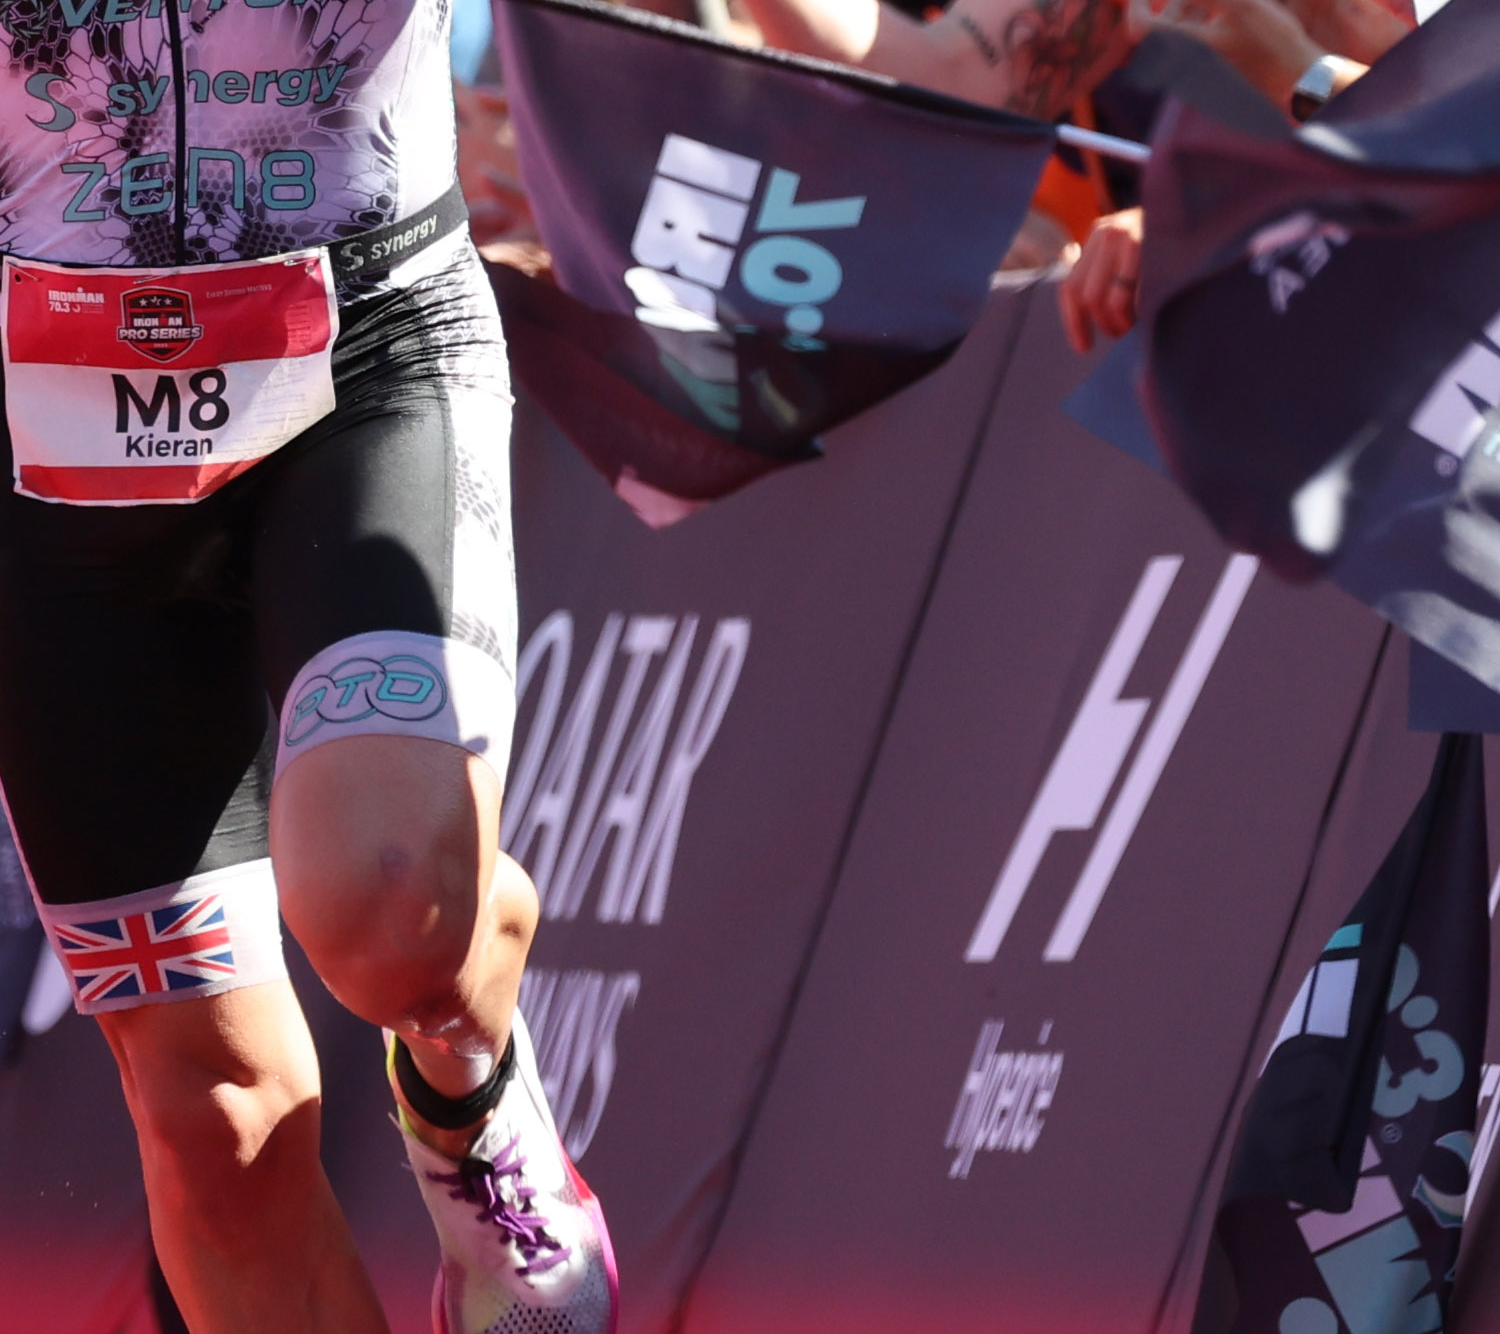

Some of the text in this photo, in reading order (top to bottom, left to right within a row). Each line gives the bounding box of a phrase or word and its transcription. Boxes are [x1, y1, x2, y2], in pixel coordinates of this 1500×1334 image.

[106, 63, 348, 118] synergy
[61, 146, 317, 223] ZEN8
[370, 211, 440, 262] synergy
[47, 286, 105, 304] IRONMAN
[48, 300, 71, 314] 70.3
[118, 327, 202, 341] PRO SERIES
[110, 368, 231, 434] M8
[124, 433, 214, 459] Kieran
